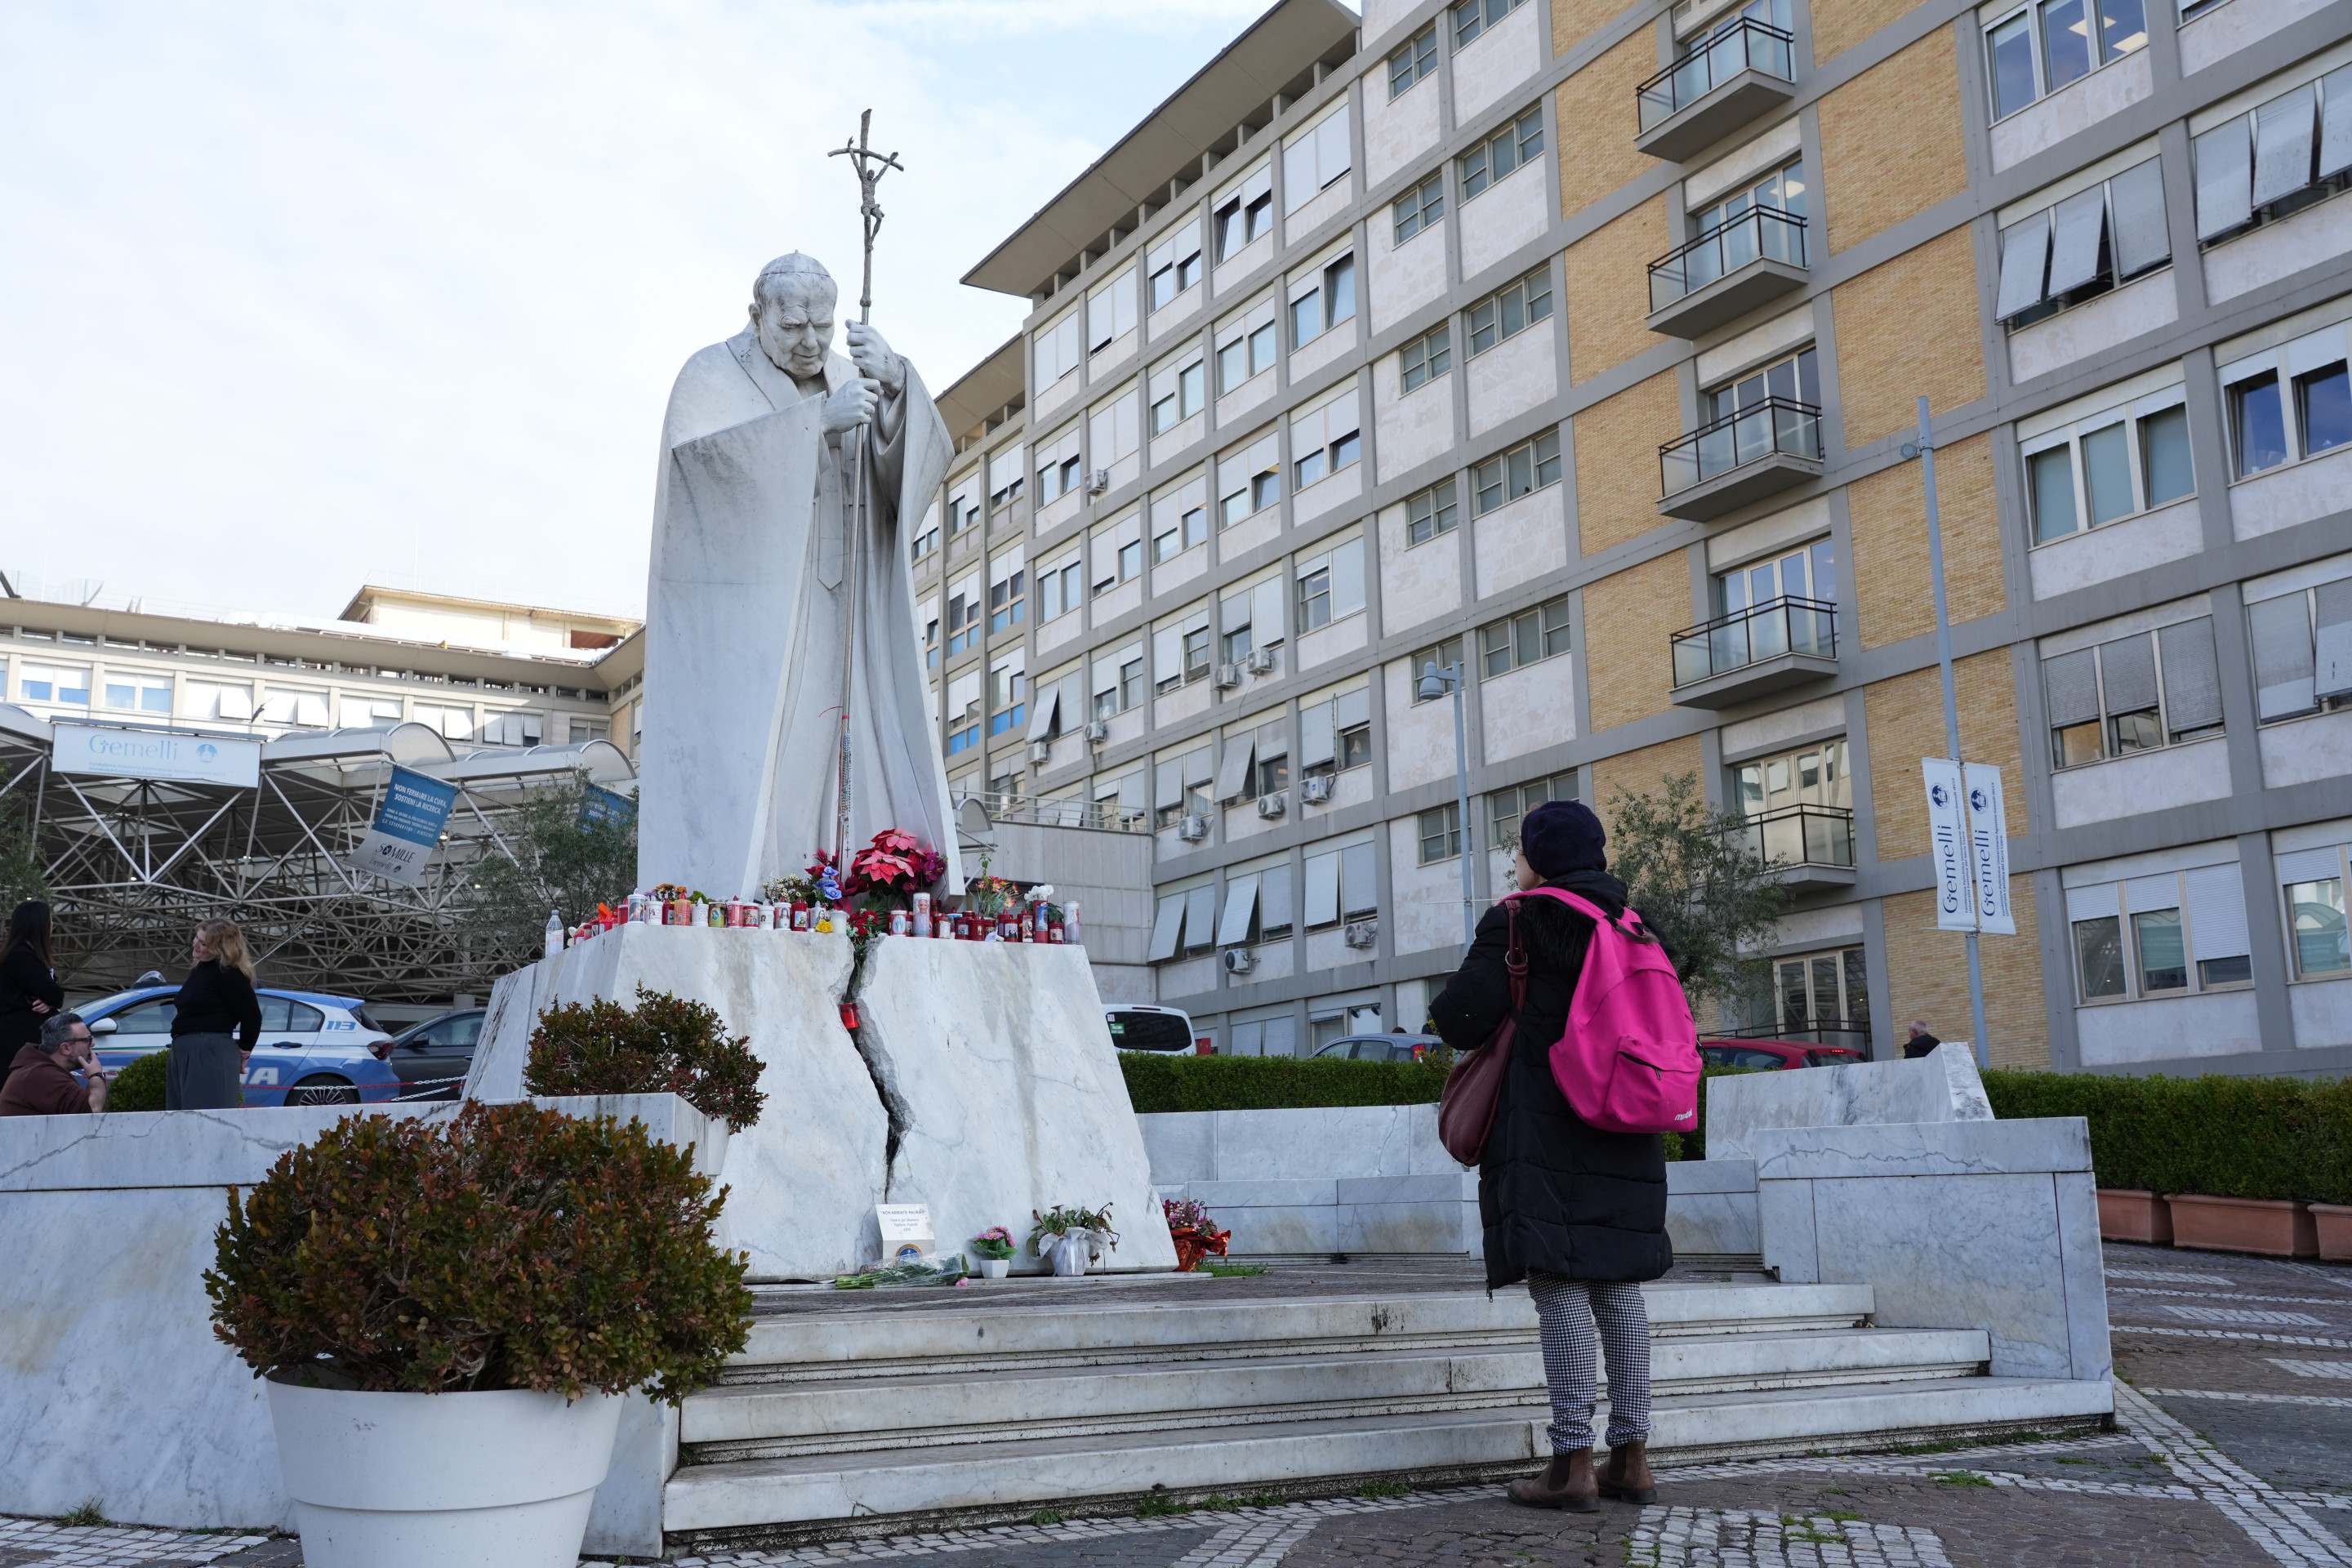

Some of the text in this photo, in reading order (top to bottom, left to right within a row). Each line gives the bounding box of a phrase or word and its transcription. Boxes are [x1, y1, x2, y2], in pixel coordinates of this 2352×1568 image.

[89, 734, 178, 760] Gemelli
[394, 783, 407, 793] NON
[407, 787, 426, 800] FERMARE
[394, 793, 441, 814] SOSTIENI LA RICERCA
[1937, 825, 1958, 913] Gemelli
[1974, 830, 1995, 916] Gemelli
[327, 1020, 357, 1031] 113
